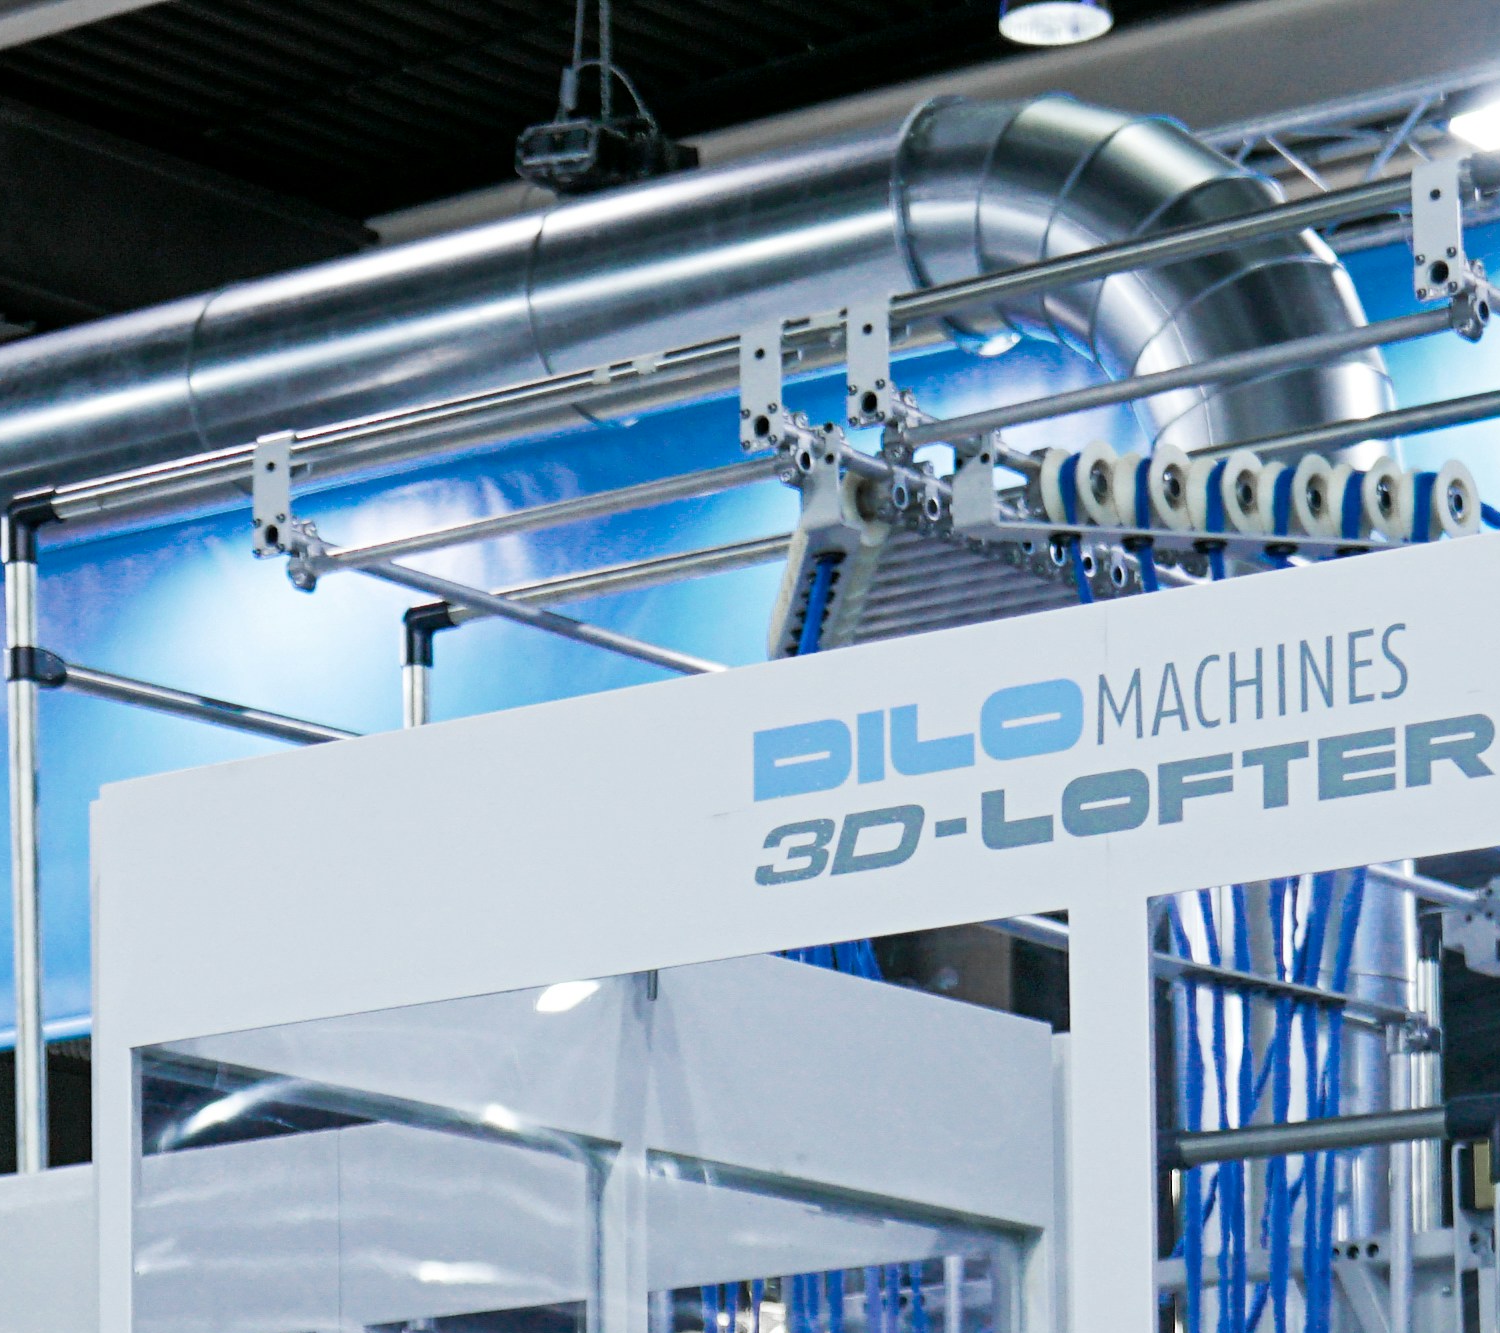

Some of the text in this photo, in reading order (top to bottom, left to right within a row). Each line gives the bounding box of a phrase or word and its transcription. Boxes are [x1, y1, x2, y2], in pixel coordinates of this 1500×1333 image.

[753, 623, 1409, 802] DILO MACHINES
[753, 712, 1496, 888] 3D-LOFTER
